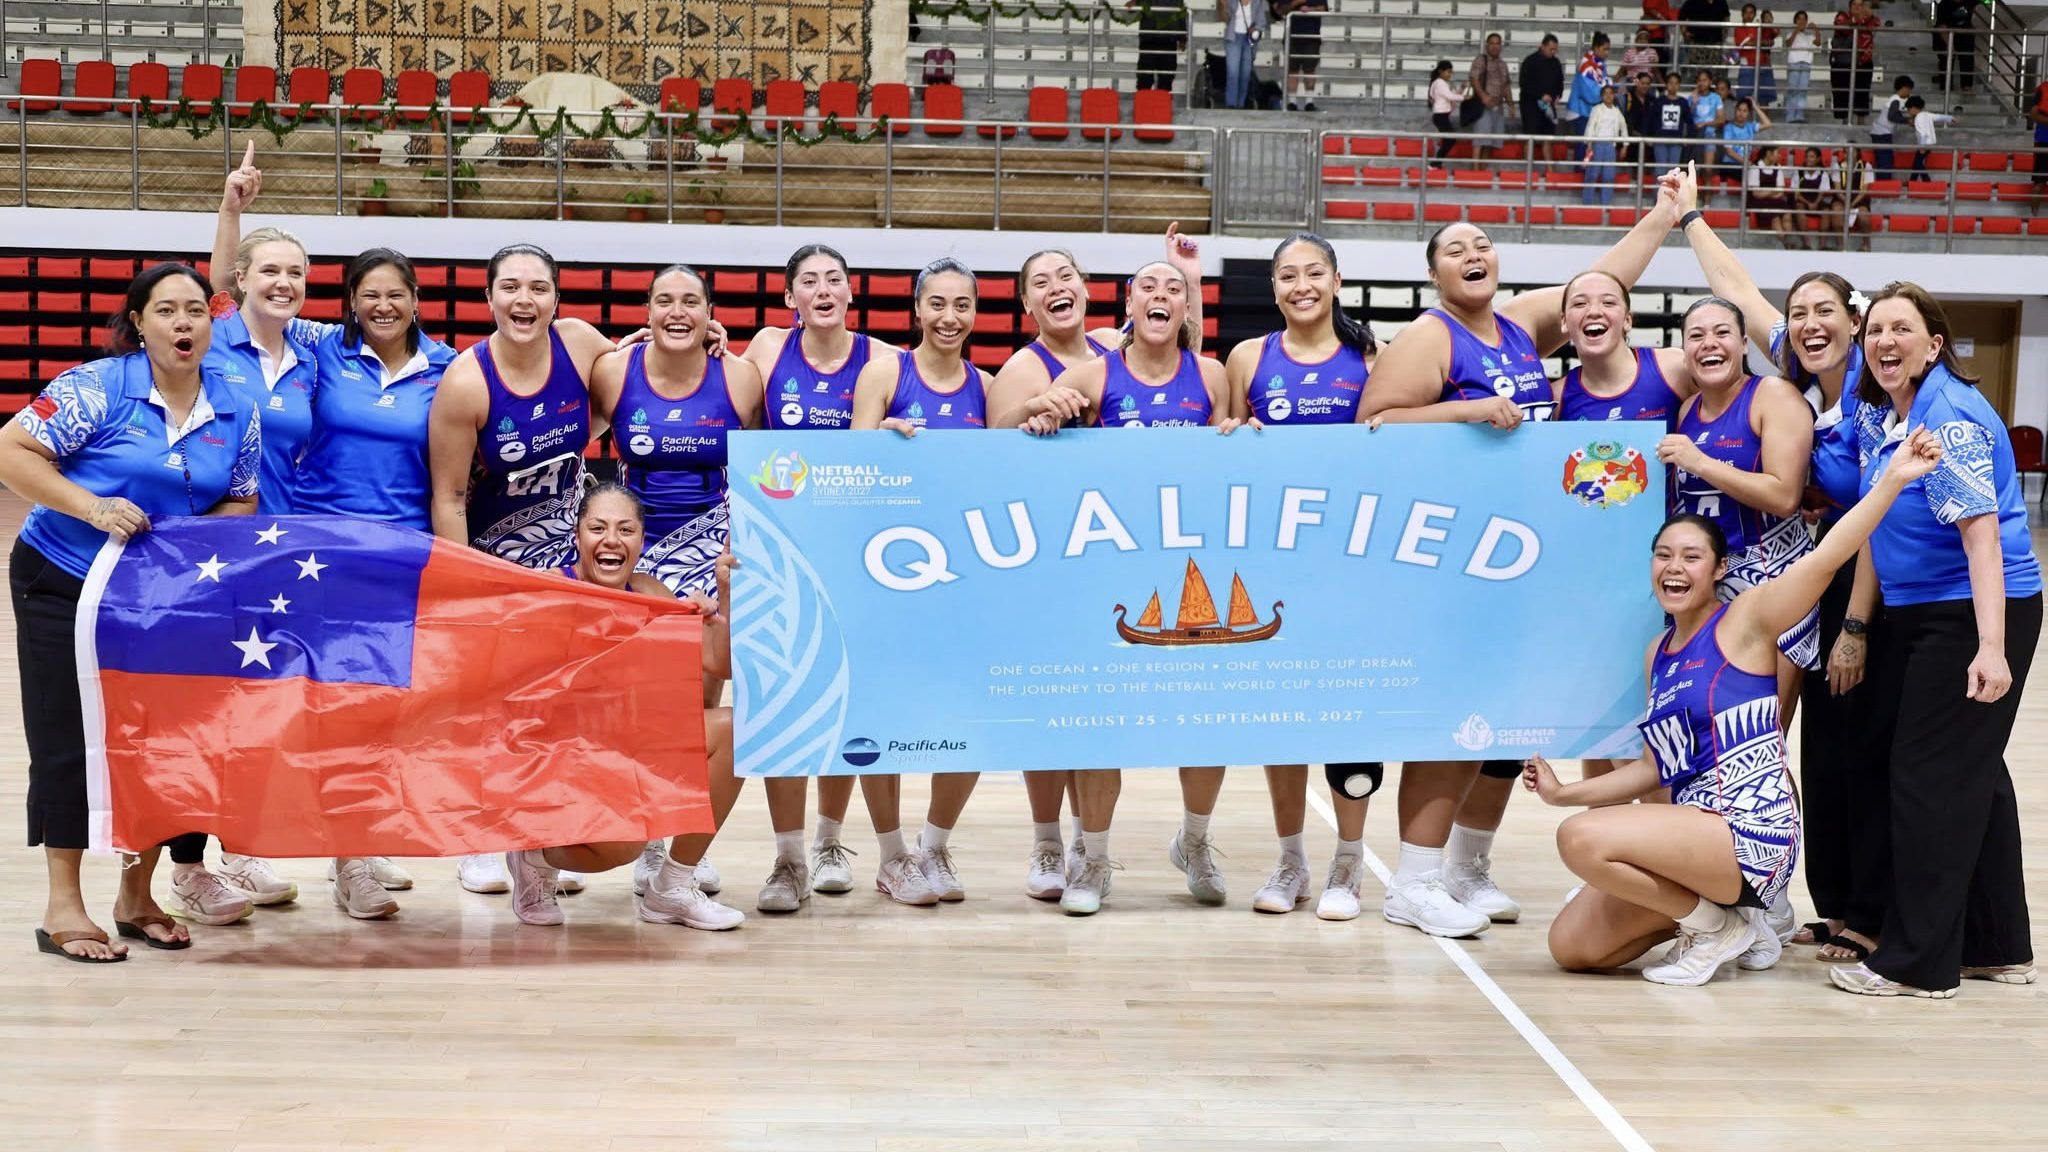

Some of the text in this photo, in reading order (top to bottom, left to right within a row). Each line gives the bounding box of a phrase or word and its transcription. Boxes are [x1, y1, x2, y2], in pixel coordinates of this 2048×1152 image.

[1297, 397, 1351, 407] PacificAus
[809, 407, 854, 420] PacificAu
[1297, 406, 1331, 416] Sports
[809, 415, 840, 426] Sports
[532, 422, 579, 446] PacificAus
[532, 436, 564, 454] Sports
[661, 436, 717, 445] PacificAus
[661, 444, 697, 454] Sports
[811, 464, 882, 476] NETBALL
[812, 475, 913, 487] WORLD CUP
[812, 486, 872, 496] SYDNEY 2027
[862, 484, 1543, 592] QUALIFIED
[989, 657, 1418, 676] ONE OCEAN ONE REGION ONE WORLD CUP DREAM.
[989, 676, 1420, 696] THE JOURNEY TO THE NETBALL WORLD CUP SYDNEY 2027
[1047, 714, 1128, 729] AUGUST
[1135, 713, 1157, 726] 25
[1176, 713, 1185, 725] 5
[1319, 709, 1364, 722] 2027
[1497, 728, 1556, 738] OCEANIA
[888, 739, 967, 752] PacificAus
[1498, 736, 1552, 746] NETBALL
[889, 752, 938, 764] Sports
